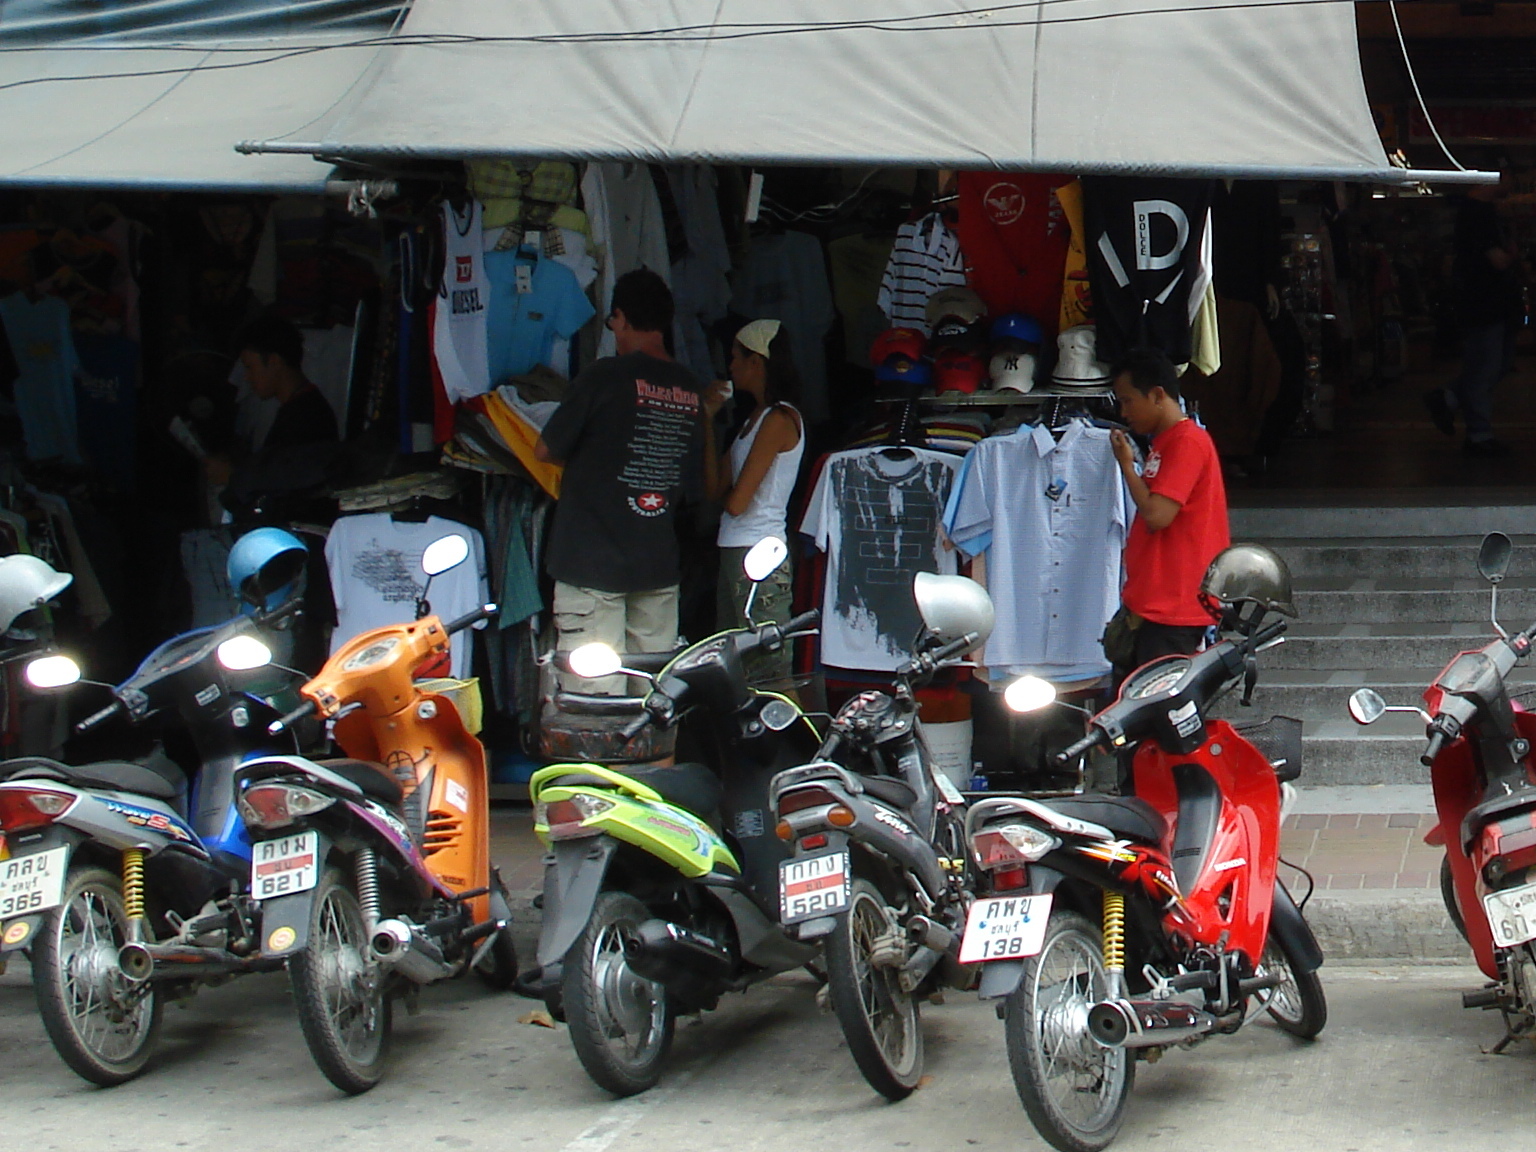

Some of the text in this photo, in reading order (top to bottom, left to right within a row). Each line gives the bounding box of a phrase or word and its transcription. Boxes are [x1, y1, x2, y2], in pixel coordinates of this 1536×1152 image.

[1138, 214, 1147, 256] DOLCE
[262, 871, 303, 894] 621
[2, 890, 43, 915] 365
[793, 891, 838, 914] 520
[983, 936, 1023, 958] 138
